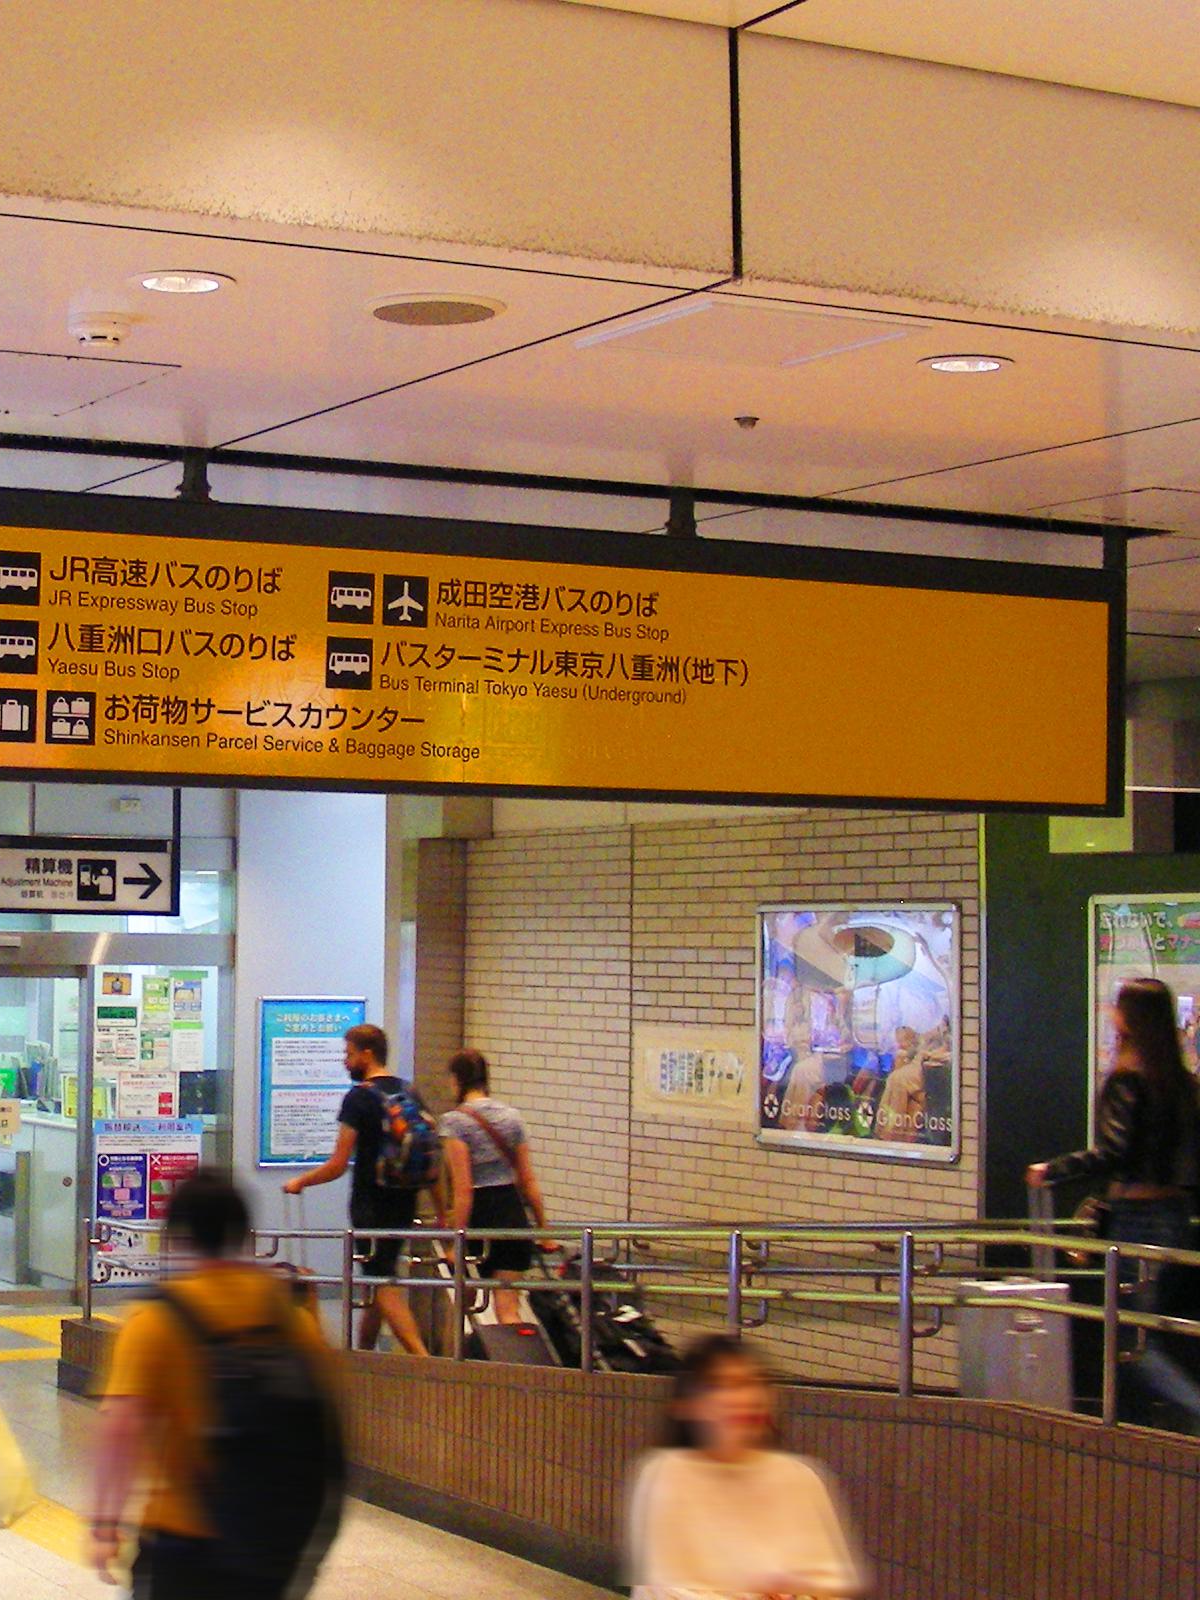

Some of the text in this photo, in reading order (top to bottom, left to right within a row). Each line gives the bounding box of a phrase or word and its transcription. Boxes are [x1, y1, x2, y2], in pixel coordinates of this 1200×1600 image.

[49, 556, 283, 595] JR高速バスのりば
[48, 590, 258, 618] JR Expressway Bus Stop
[436, 580, 659, 618] 成田空港バスのりば
[48, 622, 298, 662] 八重洲口バスのりば
[435, 613, 669, 642] Narita Airport Express Bus Stop
[48, 659, 180, 683] Yaesu Bus Stop
[380, 641, 748, 687] バスターミナル東京八重洲(地下)
[380, 674, 686, 704] Bus Terminal Tokyo Yaesu (Underground)
[104, 694, 425, 732] お荷物サービスカウンター
[104, 728, 480, 760] Shinkansen Parcel Service & Baggage Storage
